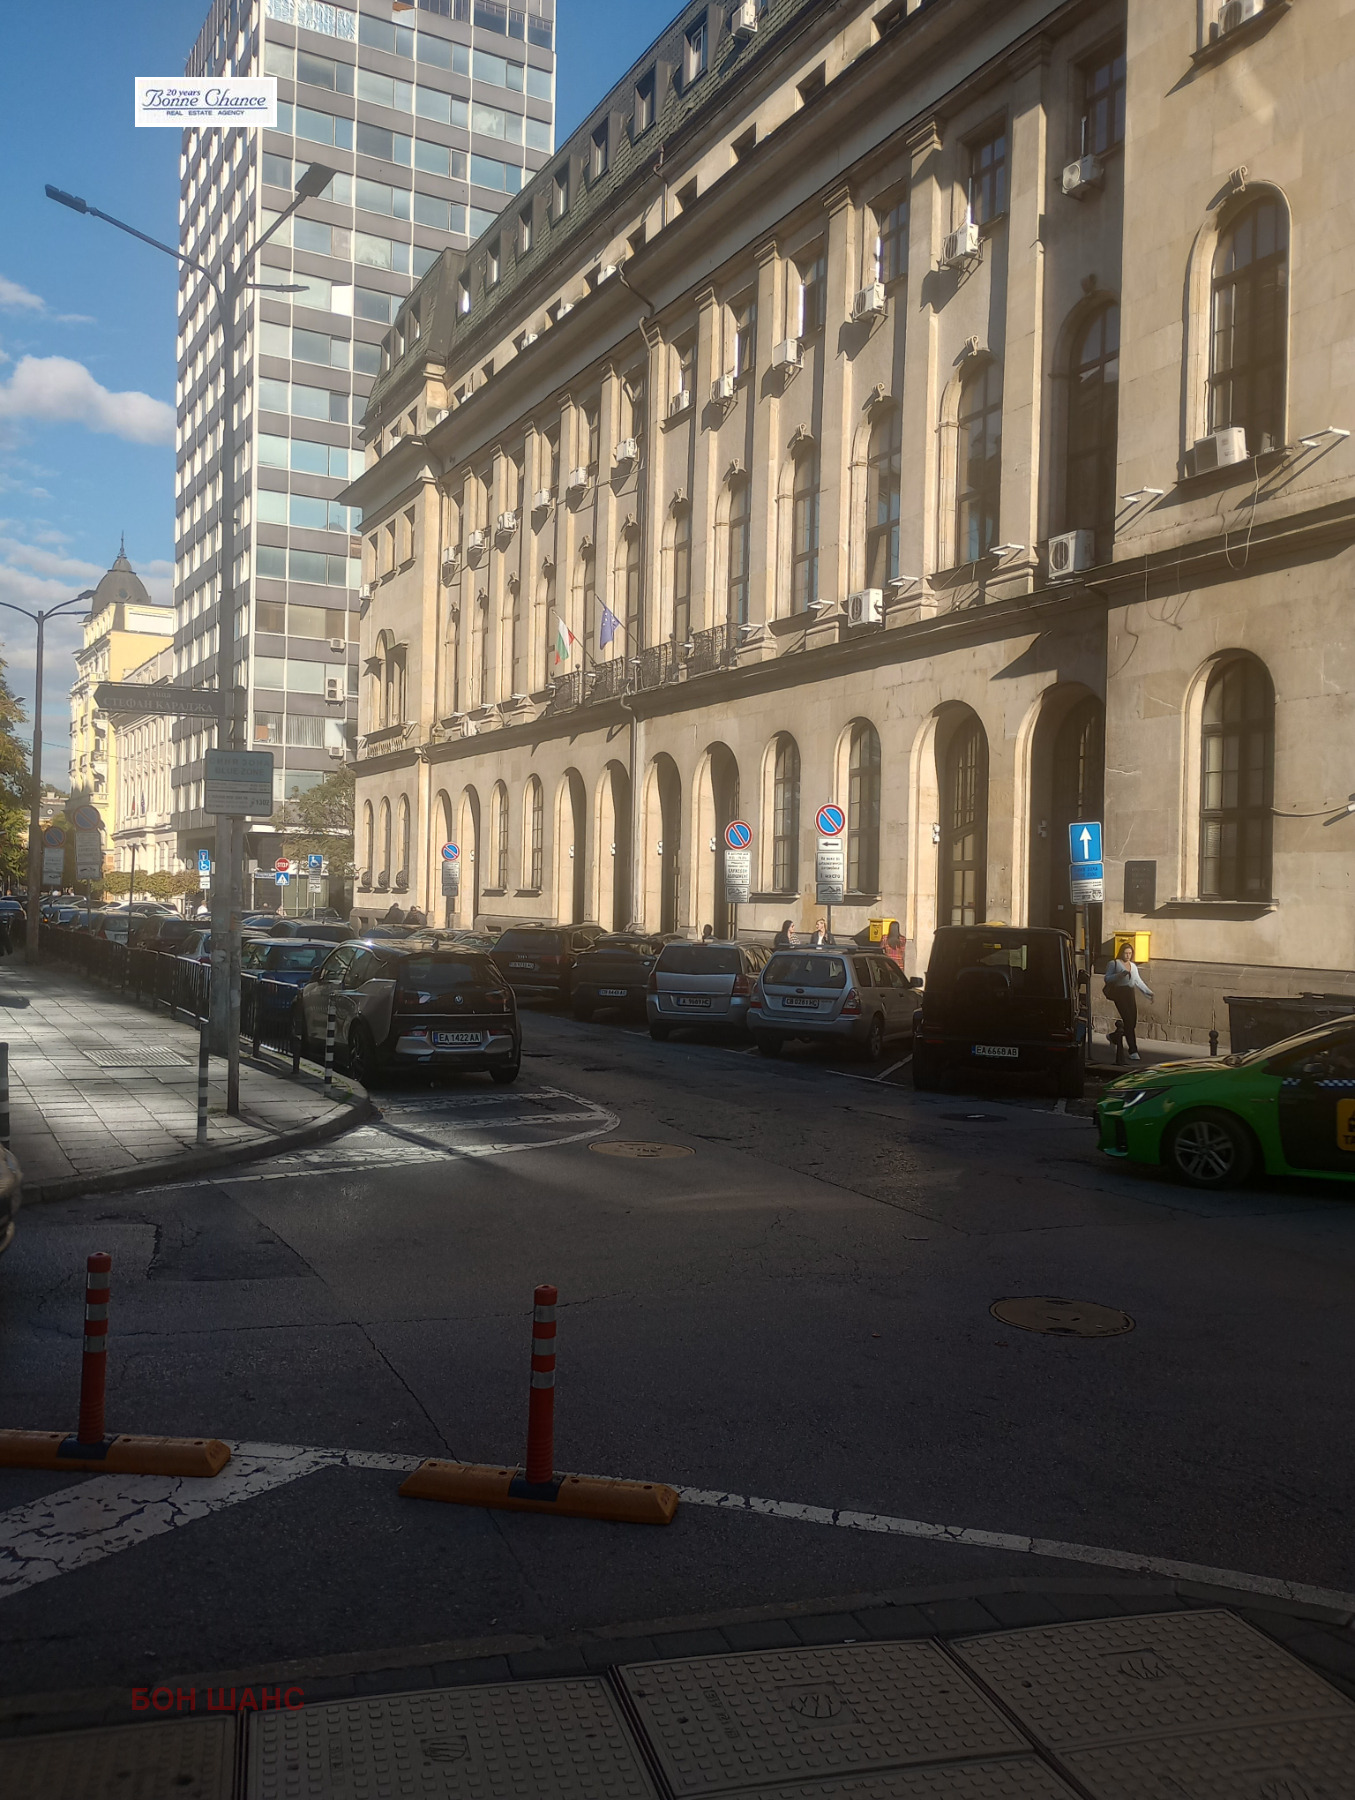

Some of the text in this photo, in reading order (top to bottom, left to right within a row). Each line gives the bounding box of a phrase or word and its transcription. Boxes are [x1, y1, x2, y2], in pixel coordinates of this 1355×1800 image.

[103, 697, 213, 713] СТЕФАН КАРАДЖА
[451, 1033, 469, 1042] 1422
